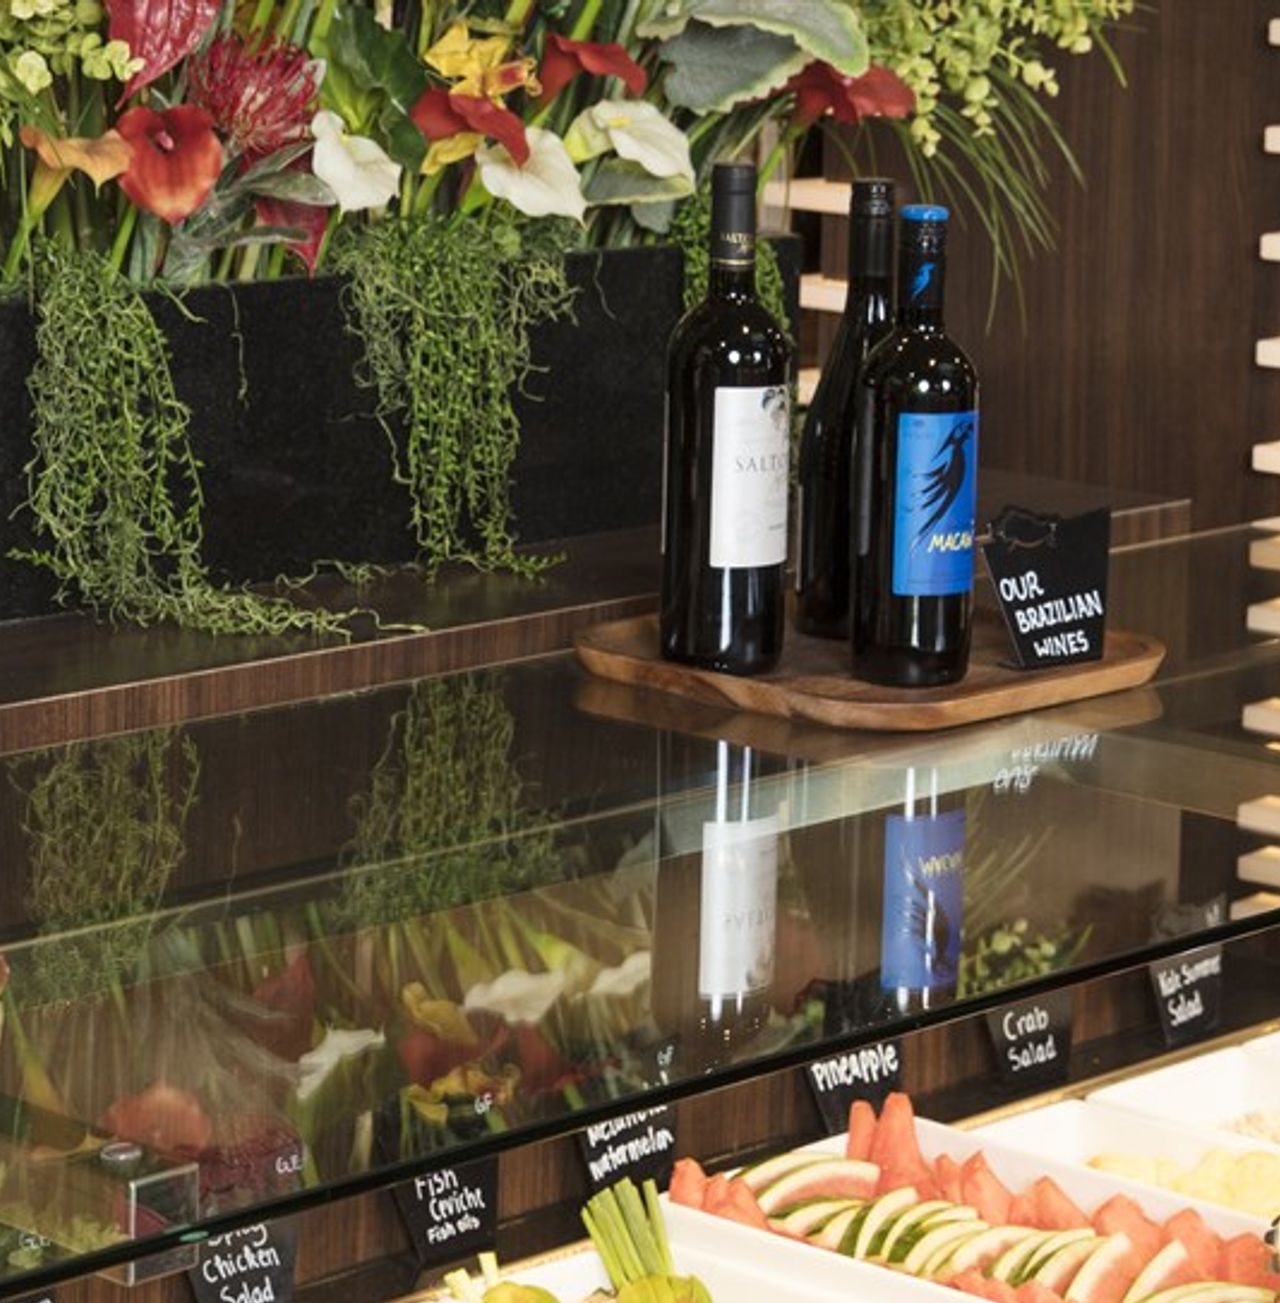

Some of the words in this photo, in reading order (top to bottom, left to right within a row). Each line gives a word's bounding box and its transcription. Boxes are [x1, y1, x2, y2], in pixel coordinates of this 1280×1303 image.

[999, 570, 1045, 602] OUR
[1014, 589, 1103, 634] BRAZILIAN
[1033, 629, 1090, 658] WINES
[1002, 1005, 1050, 1041] Crab
[1168, 989, 1204, 1027] Salad
[1007, 1034, 1058, 1072] Salad
[414, 1168, 459, 1201] Fish
[426, 1221, 457, 1245] Fish
